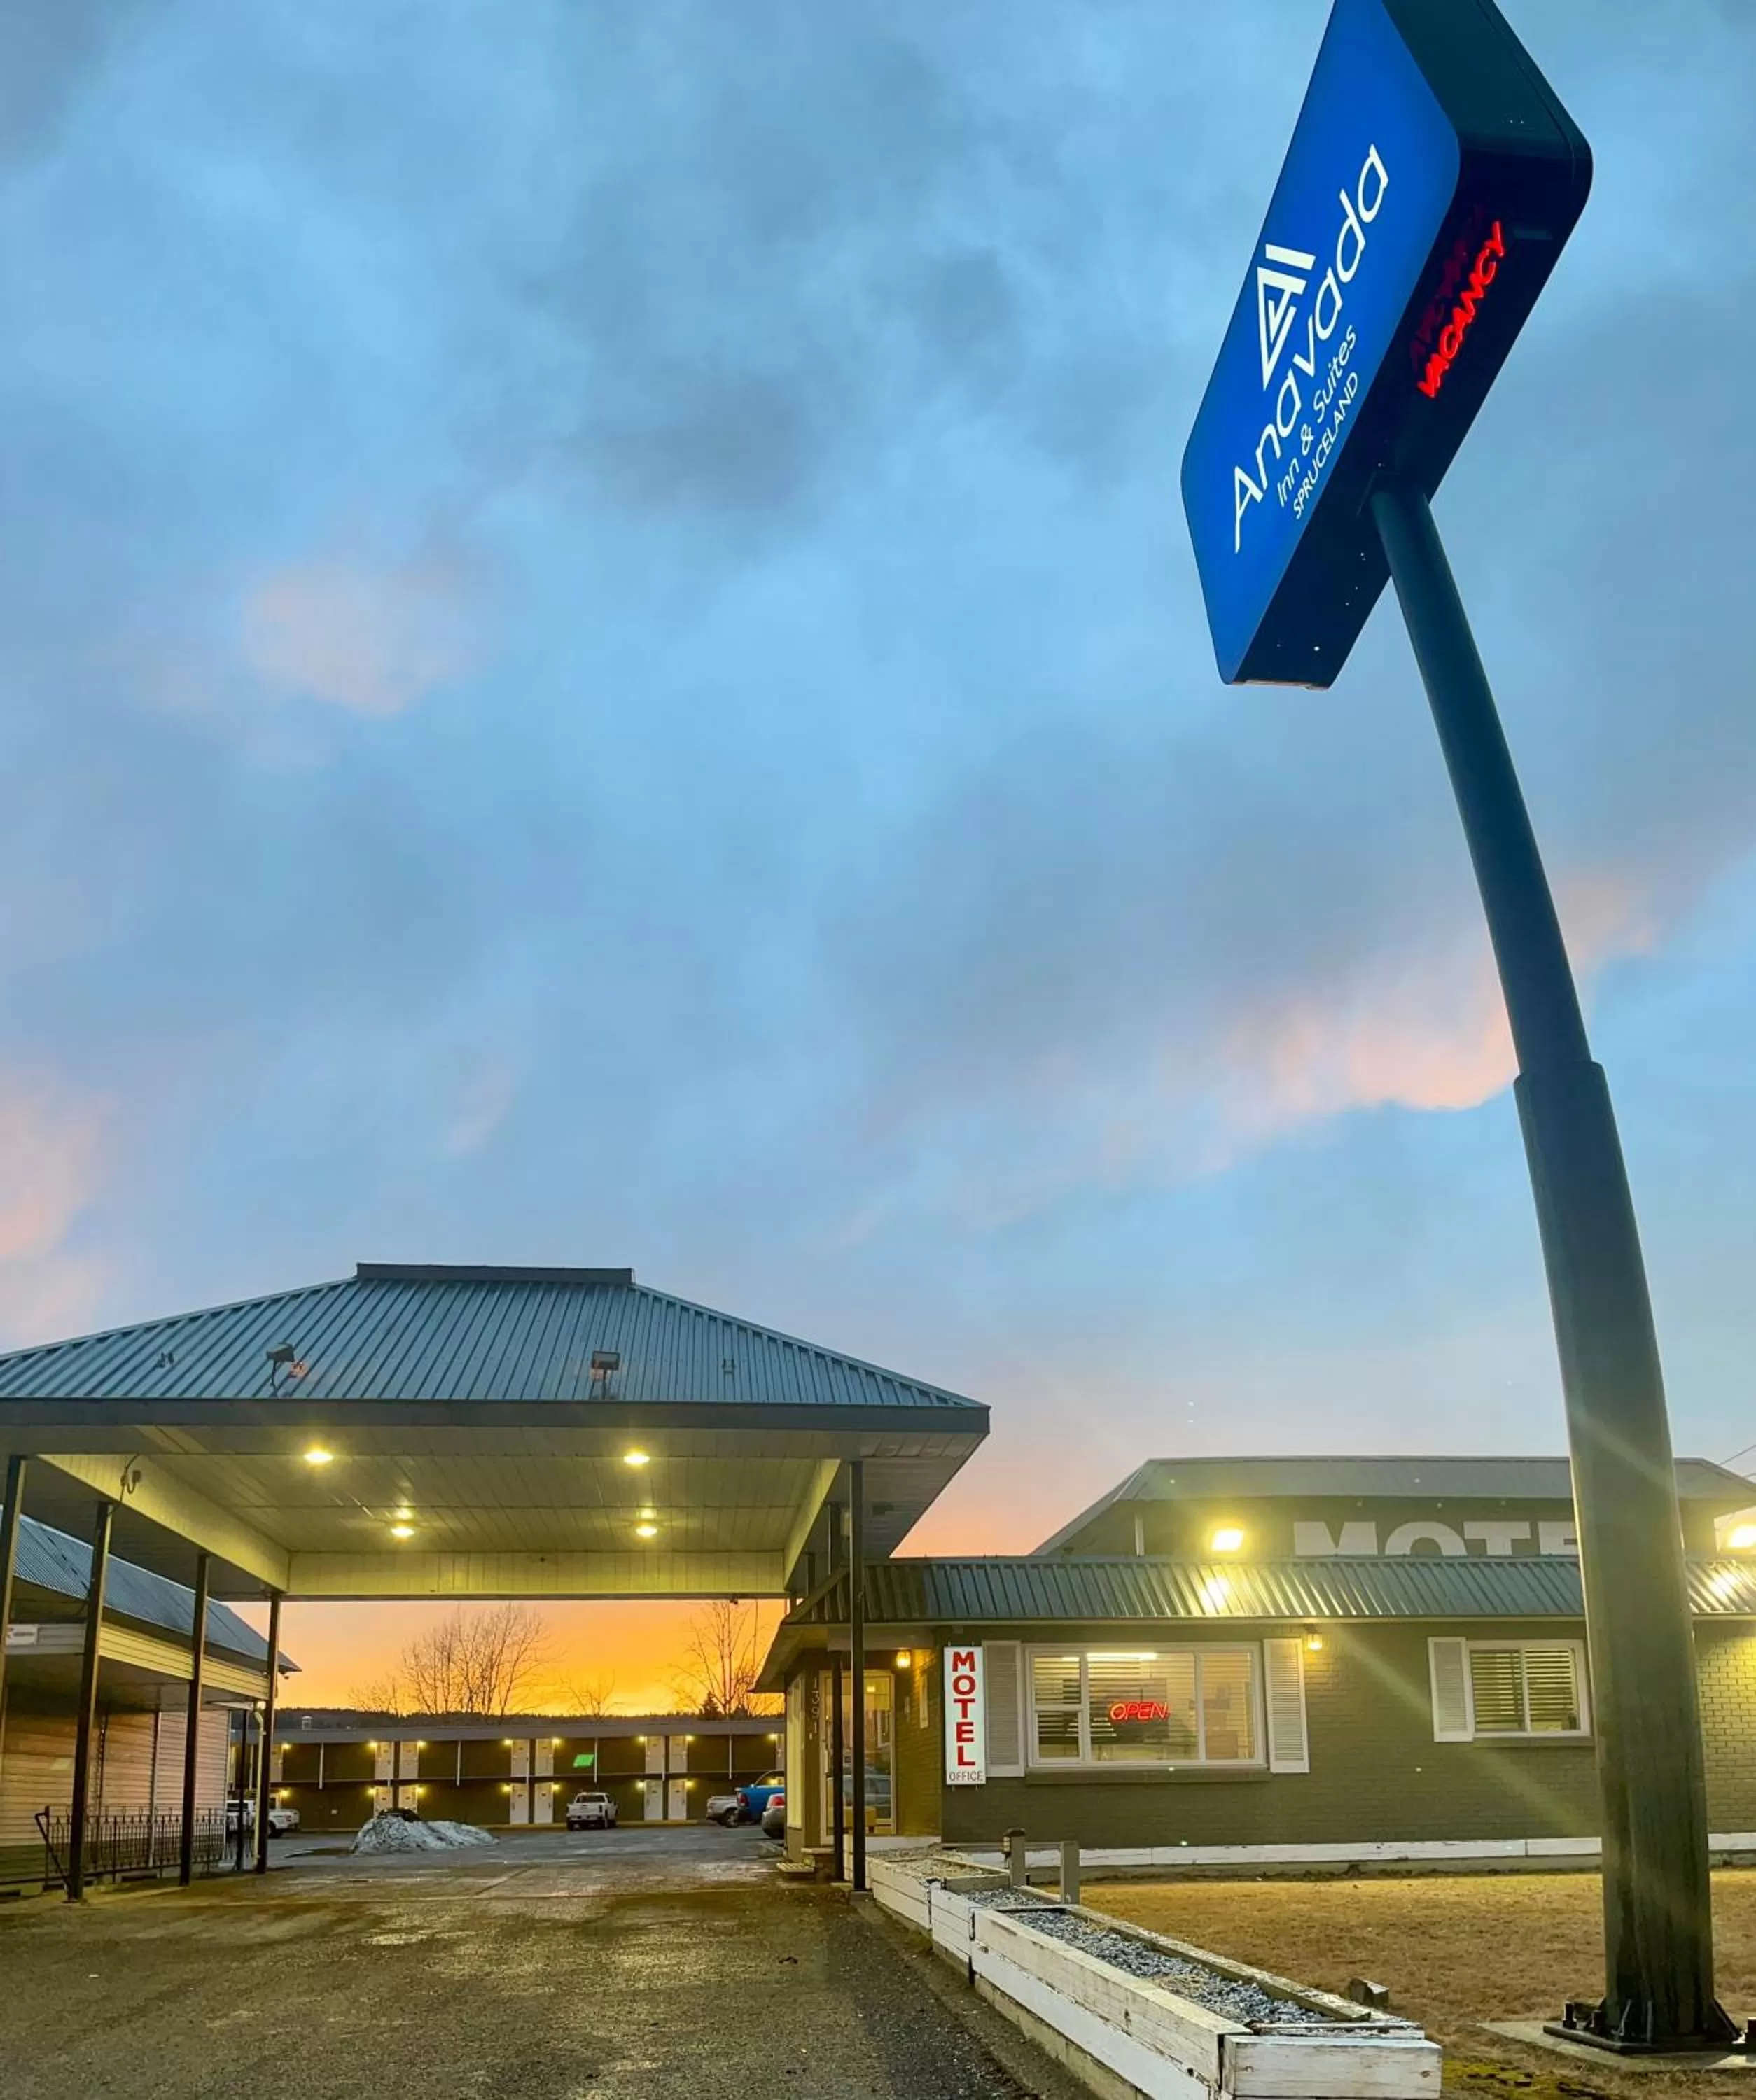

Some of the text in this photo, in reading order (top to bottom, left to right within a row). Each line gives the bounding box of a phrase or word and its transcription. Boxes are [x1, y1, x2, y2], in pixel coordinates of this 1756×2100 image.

[1235, 144, 1388, 554] Anavada
[1417, 219, 1505, 398] VACANCY
[1277, 325, 1356, 507] Inn & Suites
[1293, 372, 1358, 519] SPRUCELAND
[949, 1771, 984, 1782] OFFICE
[952, 1651, 975, 1766] MOTEL
[1110, 1702, 1167, 1720] OPEN
